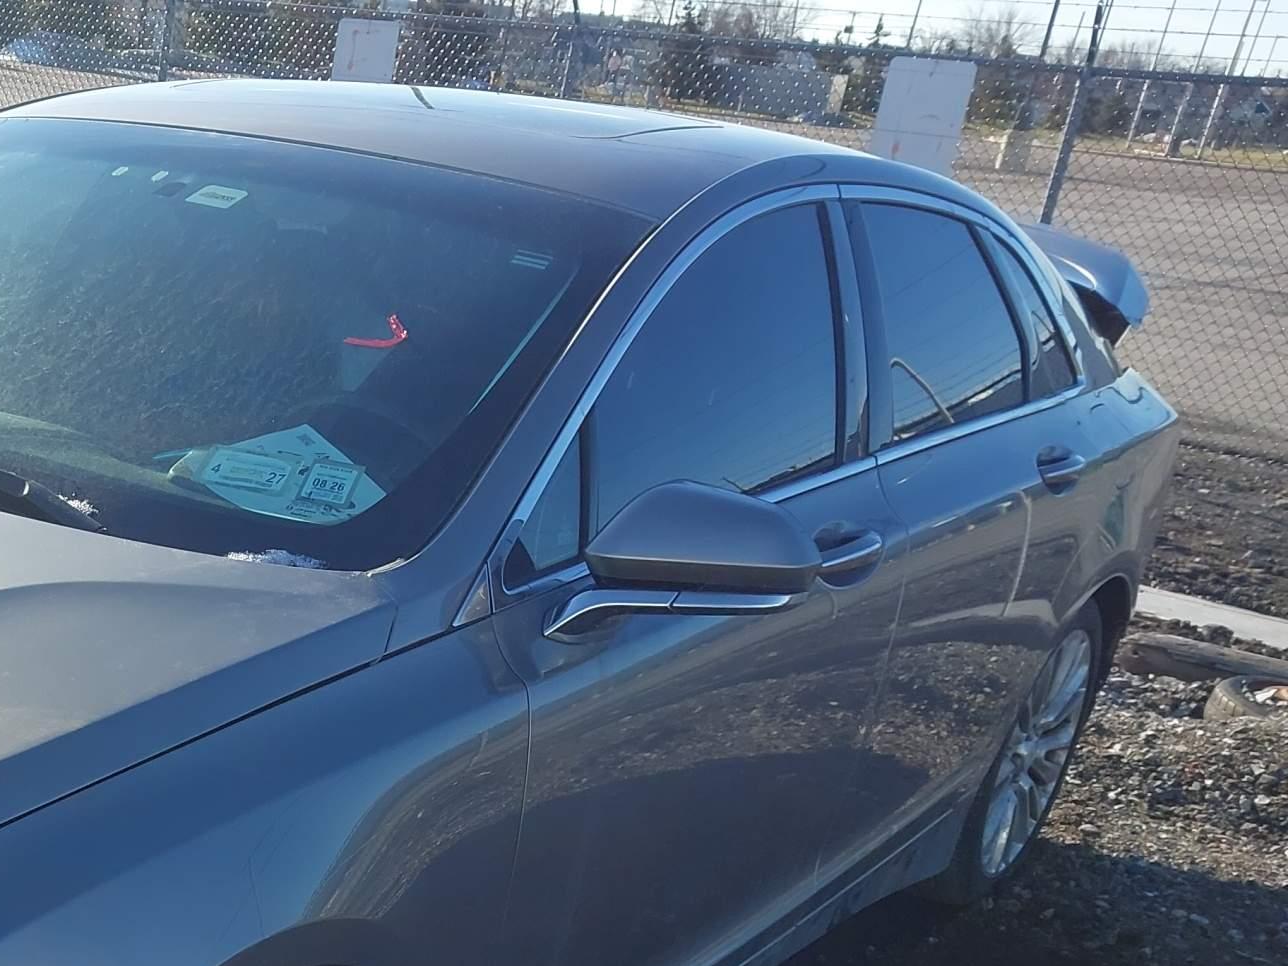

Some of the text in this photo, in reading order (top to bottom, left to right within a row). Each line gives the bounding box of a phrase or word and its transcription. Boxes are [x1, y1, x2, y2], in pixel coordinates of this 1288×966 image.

[265, 472, 286, 485] 27
[312, 478, 345, 491] 08 26
